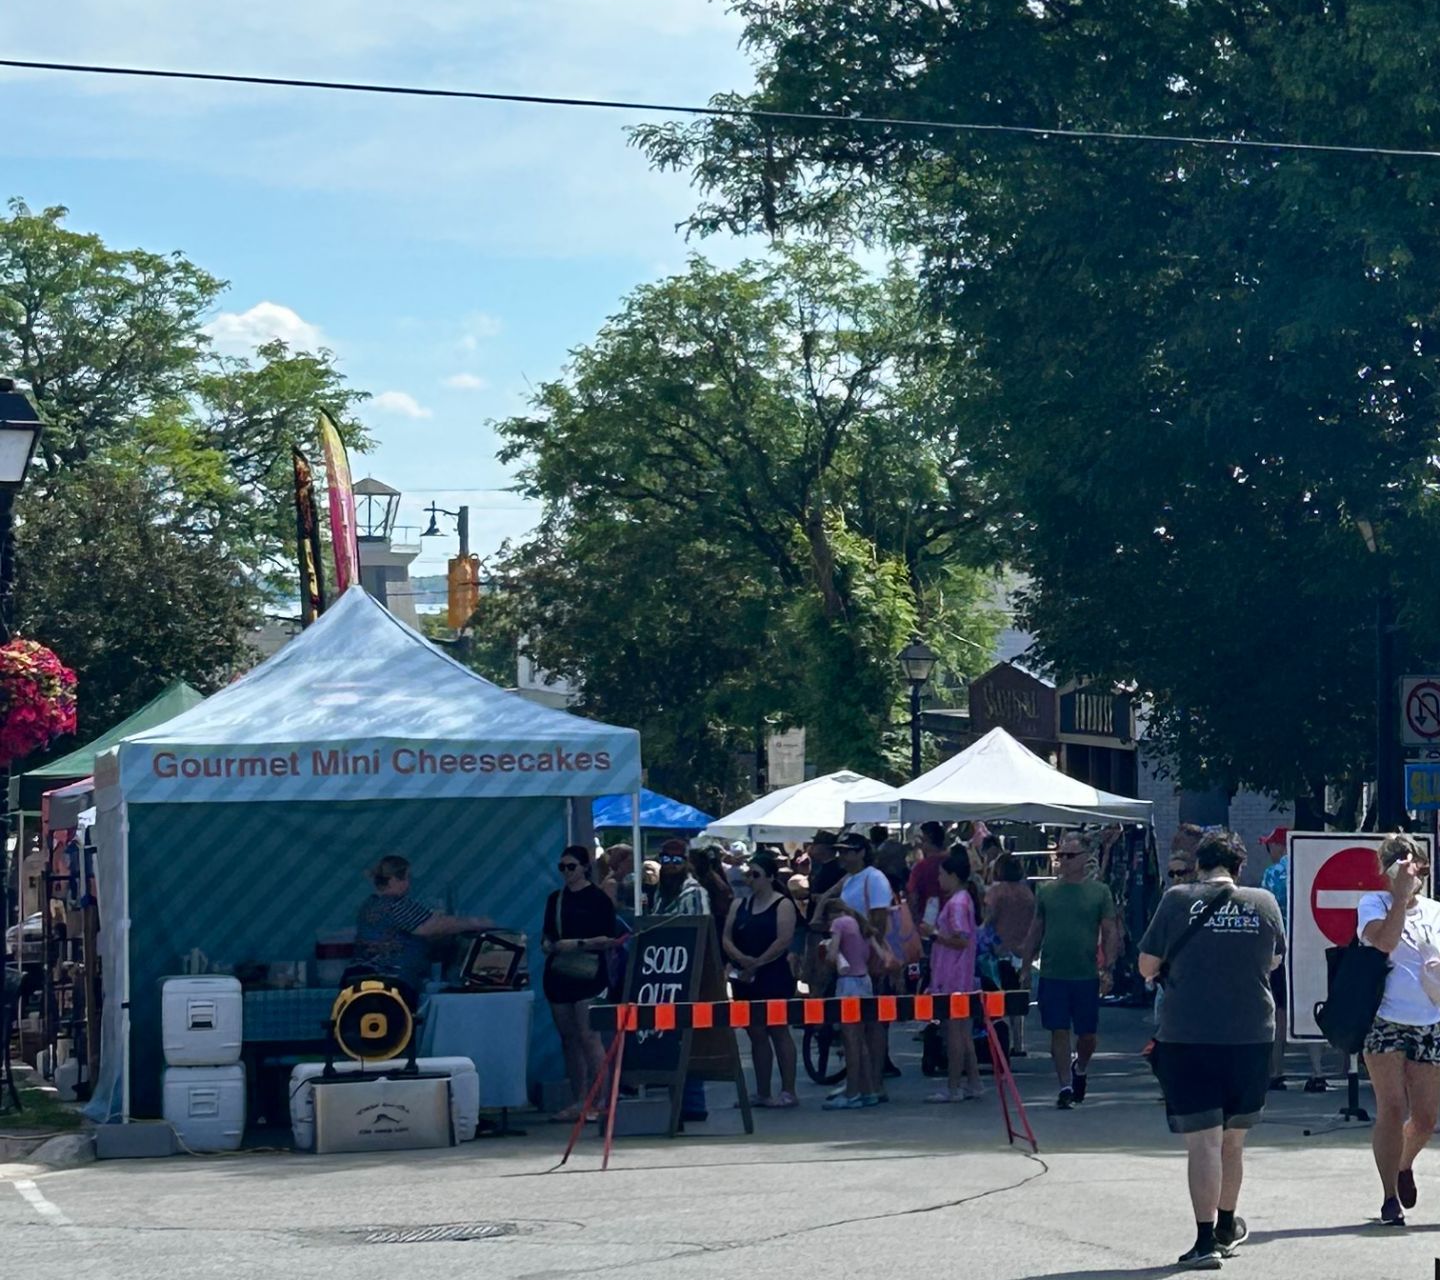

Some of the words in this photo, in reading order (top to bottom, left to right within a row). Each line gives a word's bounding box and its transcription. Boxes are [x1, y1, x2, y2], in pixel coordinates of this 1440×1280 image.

[152, 751, 300, 778] Gourmet
[312, 749, 381, 776] Mini
[391, 745, 611, 774] Cheesecakes
[642, 945, 688, 975] SOLD
[638, 983, 683, 1005] OUT
